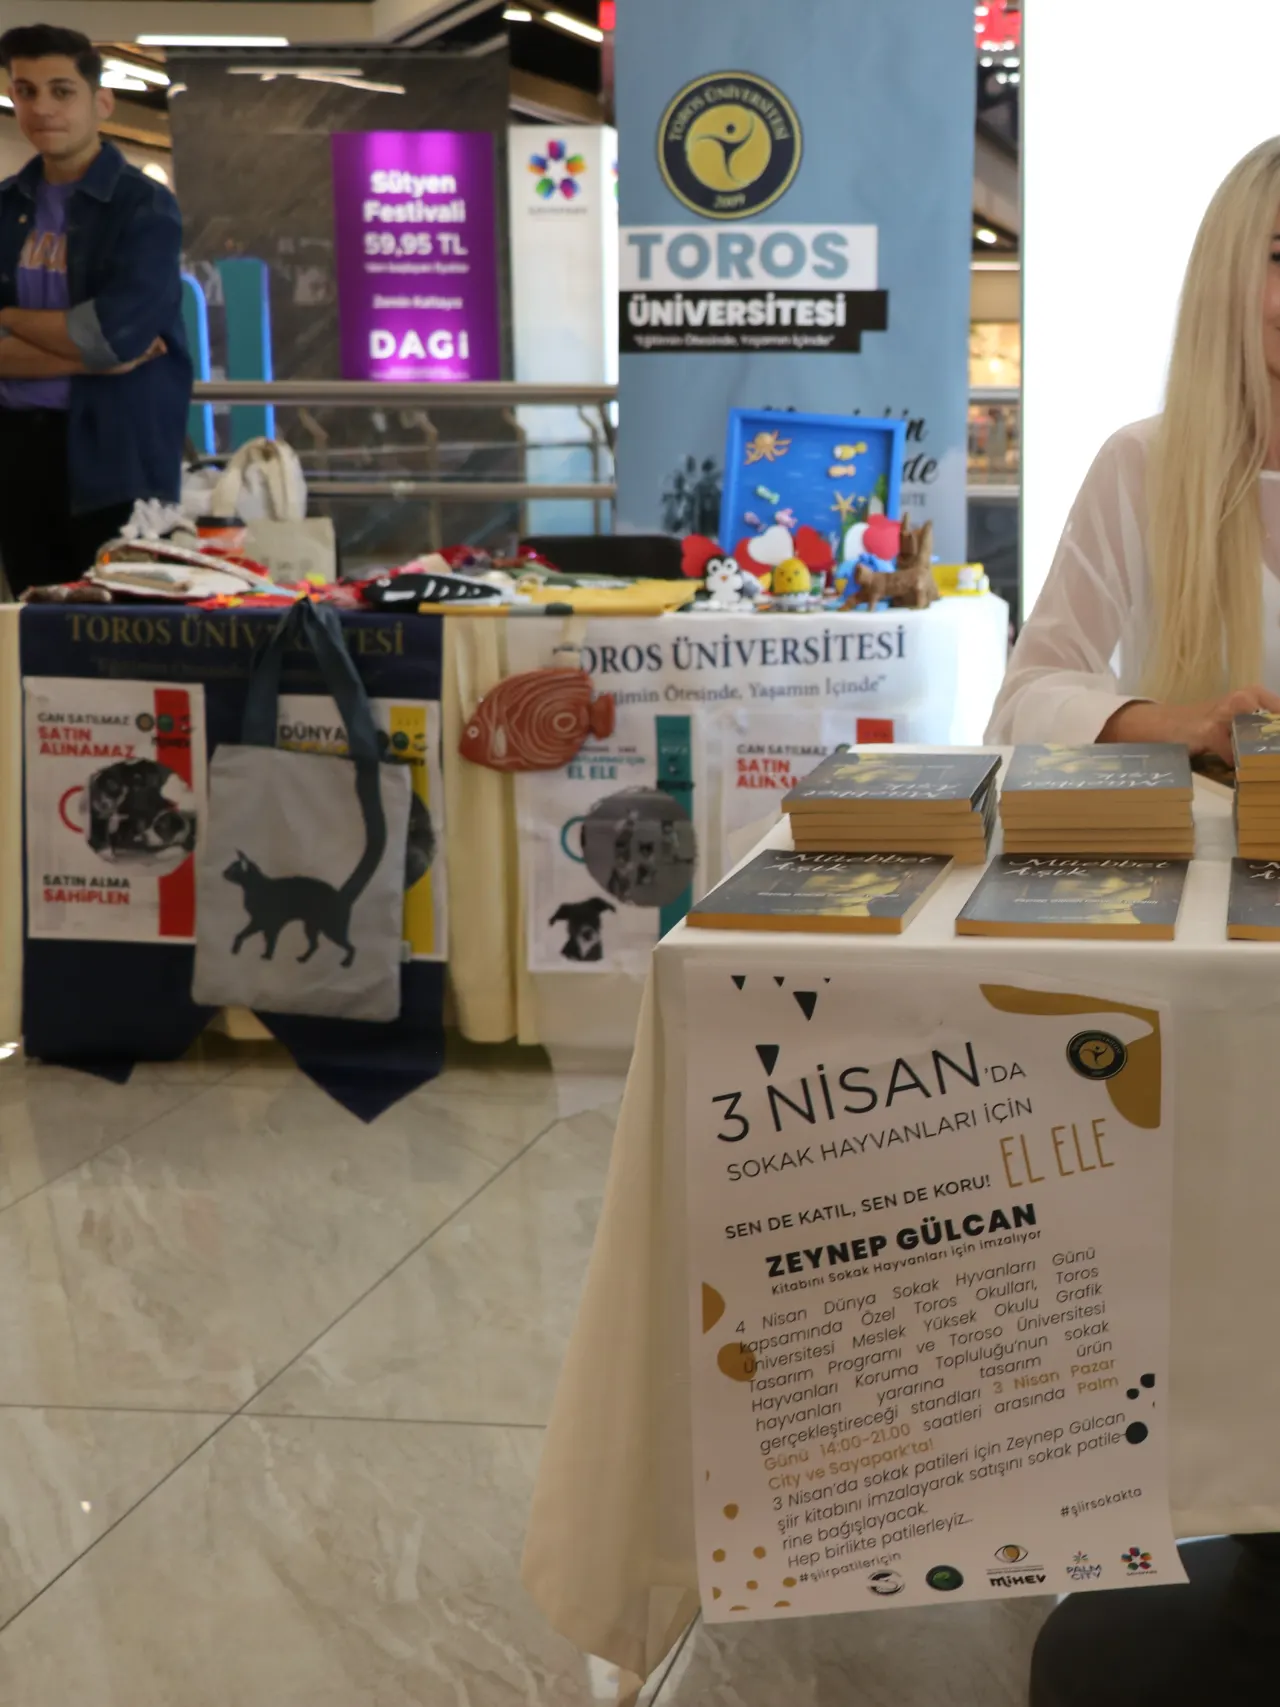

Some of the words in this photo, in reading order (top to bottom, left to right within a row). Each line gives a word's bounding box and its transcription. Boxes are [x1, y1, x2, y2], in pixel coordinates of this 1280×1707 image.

[370, 169, 457, 198] Sütyen
[363, 199, 466, 223] Festivali
[436, 232, 469, 255] TL
[628, 231, 849, 280] TOROS
[628, 292, 846, 327] ÜNİVERSİTESİ
[65, 613, 171, 644] TOROS
[553, 644, 662, 675] OROS
[673, 625, 906, 671] ÜNİVERSİTESİ
[38, 726, 92, 741] SATIN
[39, 742, 137, 759] ALINAMAZ
[737, 758, 790, 773] SATIN
[711, 1092, 749, 1143] 3
[726, 1146, 814, 1182] SOKAK
[820, 1113, 978, 1162] HAYVANLARI
[984, 1096, 1034, 1124] İÇİN
[1001, 1136, 1045, 1189] EL
[1050, 1118, 1115, 1178] ELE
[725, 1220, 763, 1239] SEN
[768, 1213, 794, 1231] DE
[798, 1204, 857, 1227] KATIL,
[861, 1194, 898, 1213] SEN
[903, 1187, 928, 1205] DE
[933, 1174, 991, 1200] KORU!
[765, 1233, 887, 1278] ZEYNEP
[896, 1203, 1038, 1250] GÜLCAN
